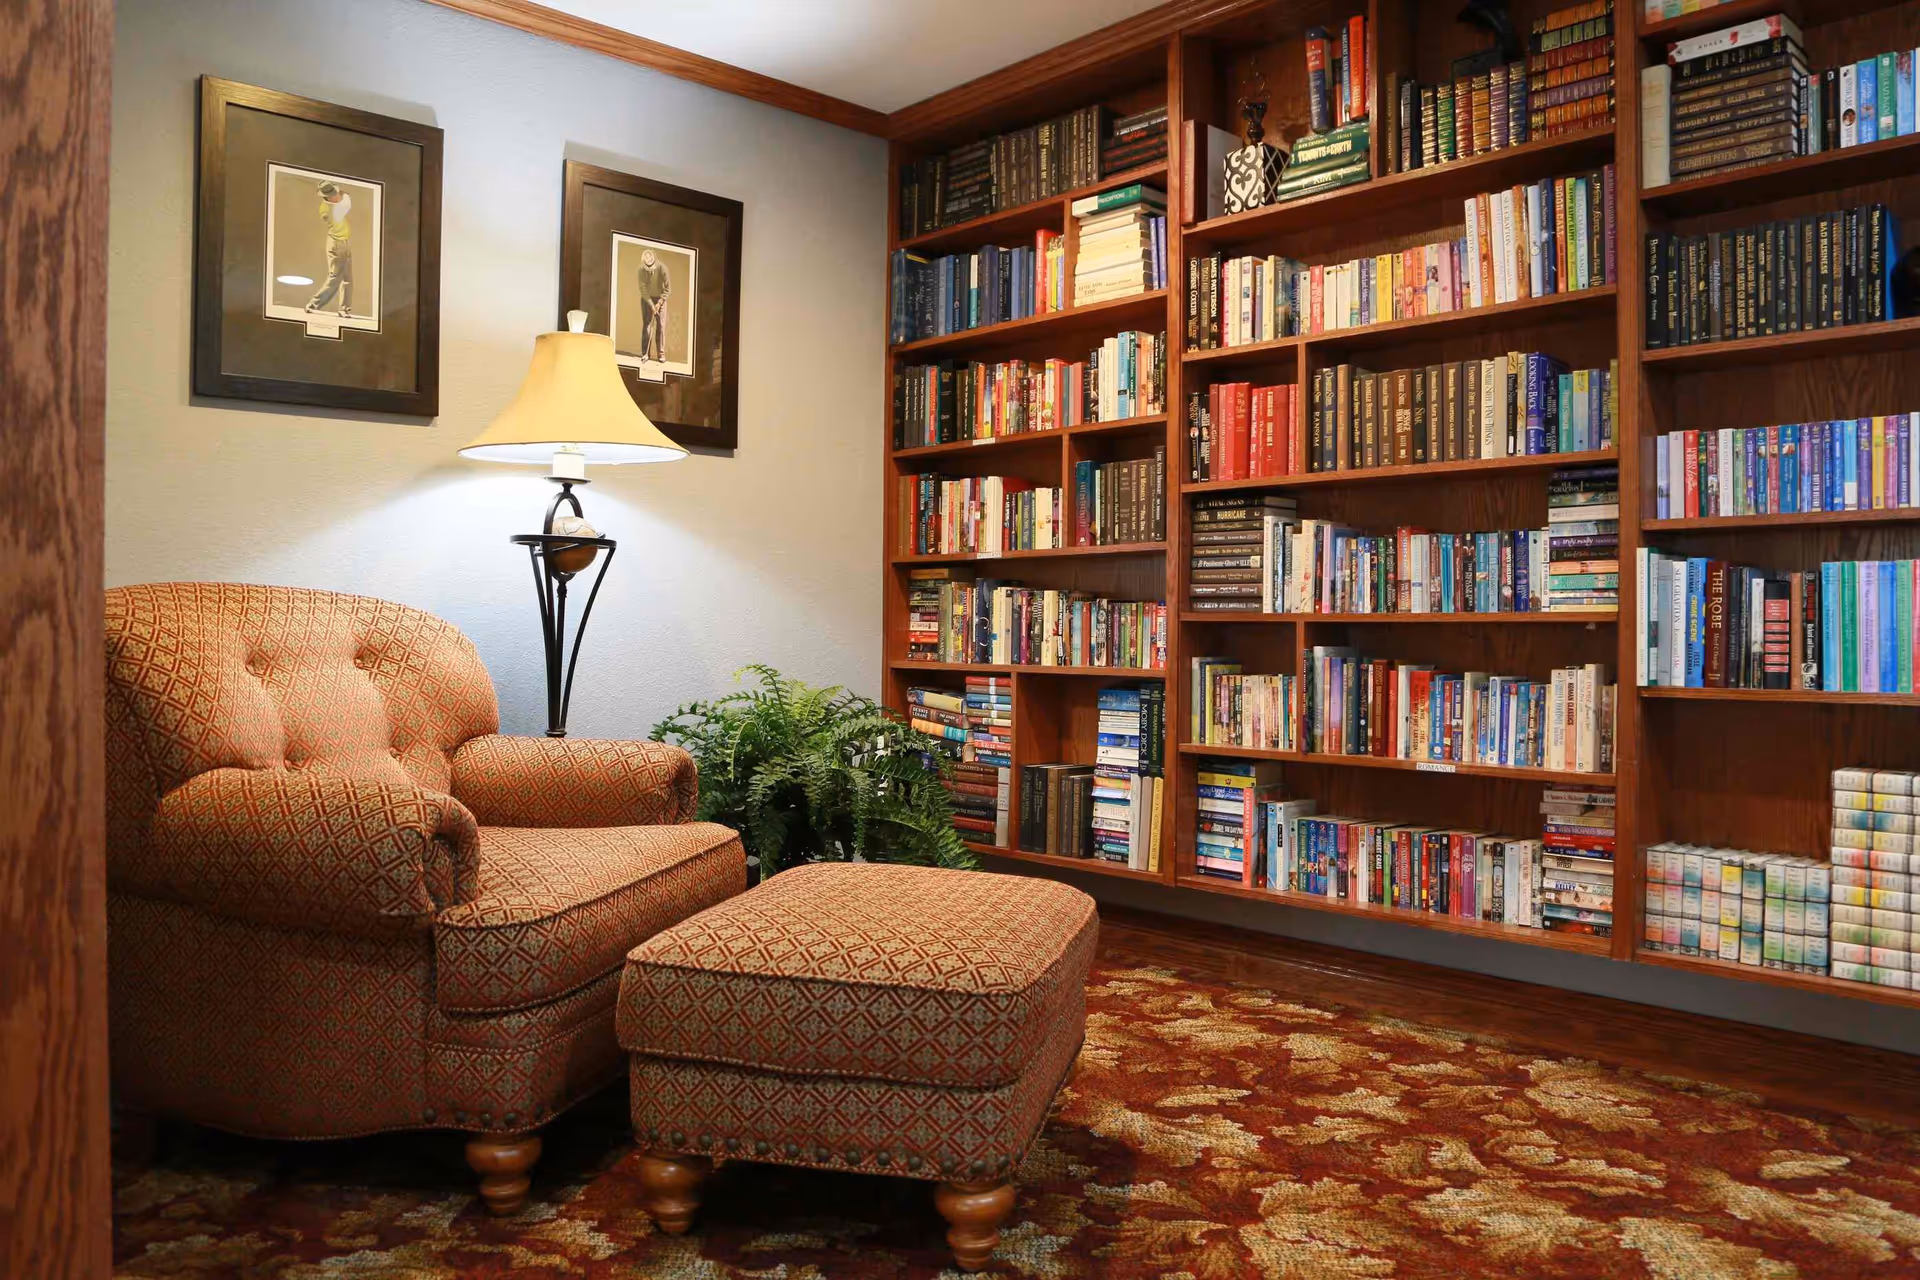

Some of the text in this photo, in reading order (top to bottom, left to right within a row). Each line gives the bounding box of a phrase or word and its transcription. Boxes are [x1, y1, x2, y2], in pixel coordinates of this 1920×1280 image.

[1555, 184, 1563, 238] GOOD CALL
[1820, 221, 1829, 275] BAD BUSINESS
[1210, 257, 1218, 318] JAMES PATTERSON
[1529, 356, 1539, 411] LOOKING BACK
[1313, 411, 1321, 447] RANSOM
[1140, 464, 1148, 478] FERN
[1140, 478, 1148, 501] MICHAELS
[1217, 510, 1247, 520] HURRICANE
[1709, 569, 1723, 629] THE ROBE
[912, 706, 930, 714] DENNIS
[1567, 682, 1575, 726] ROMAN CLASSICS
[1140, 703, 1149, 756] MOBY DICK
[1417, 763, 1455, 773] ROMANCE
[1375, 835, 1383, 870] ROBERT CRAIS
[1555, 882, 1576, 891] KELLEY
